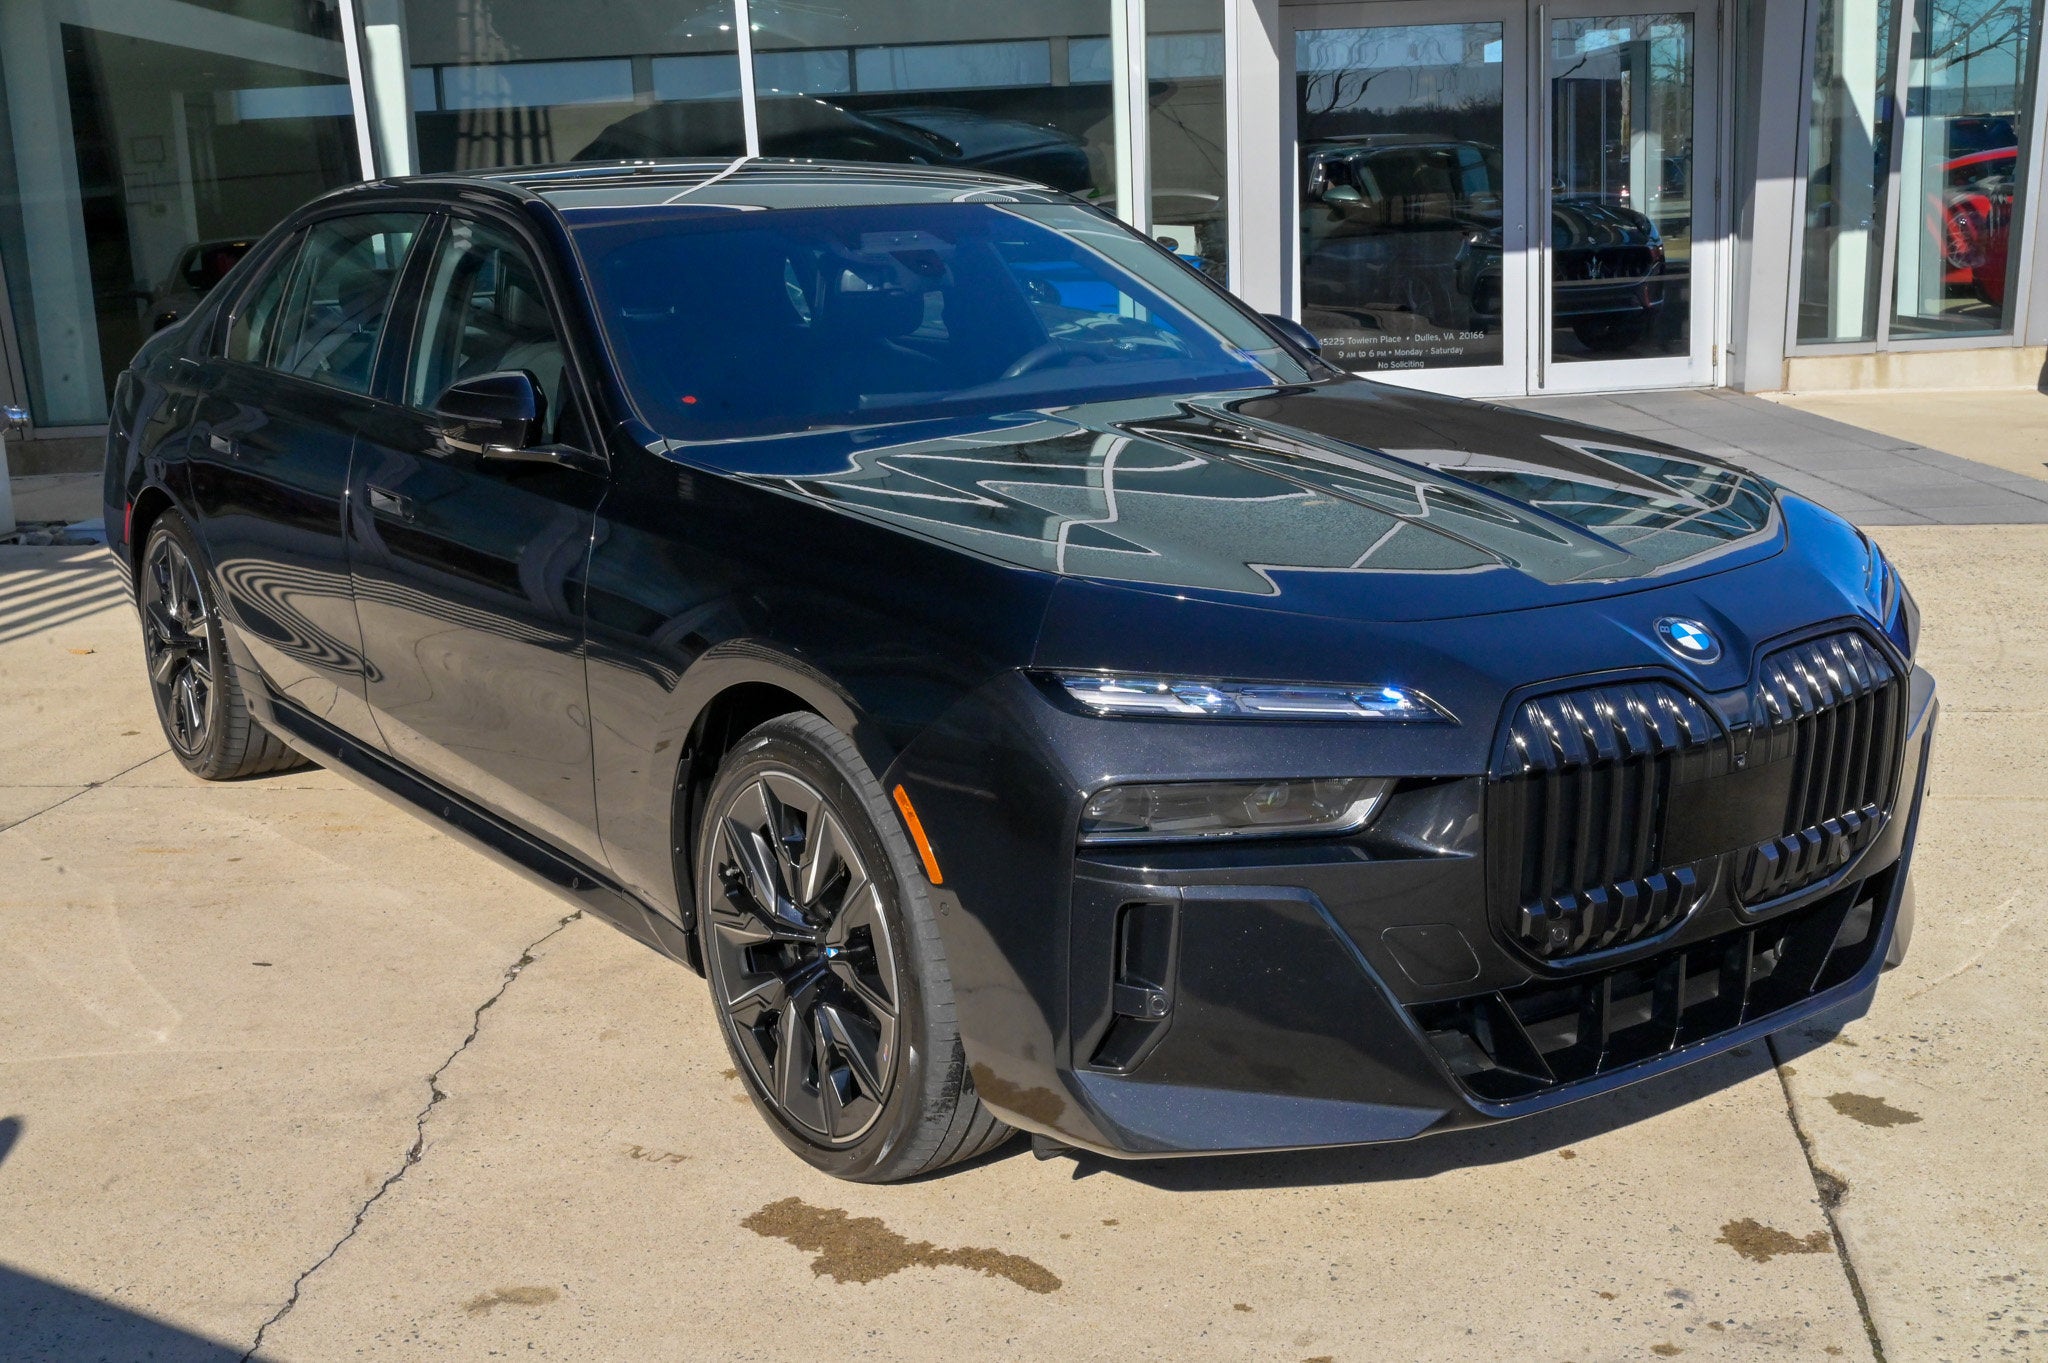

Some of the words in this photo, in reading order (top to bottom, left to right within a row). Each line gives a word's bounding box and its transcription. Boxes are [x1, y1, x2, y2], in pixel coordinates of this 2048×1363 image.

[1319, 337, 1345, 346] 45225
[1347, 336, 1378, 345] Towlern
[1380, 335, 1402, 343] Place
[1414, 333, 1441, 342] Dulles,
[1443, 332, 1455, 340] VA
[1459, 331, 1485, 340] 20166
[1338, 350, 1345, 359] 9
[1358, 350, 1367, 358] to
[1368, 349, 1375, 358] 6
[1394, 348, 1424, 357] Monday
[1430, 346, 1464, 355] Saturday
[1377, 361, 1389, 369] No
[1390, 360, 1425, 369] Soliciting
